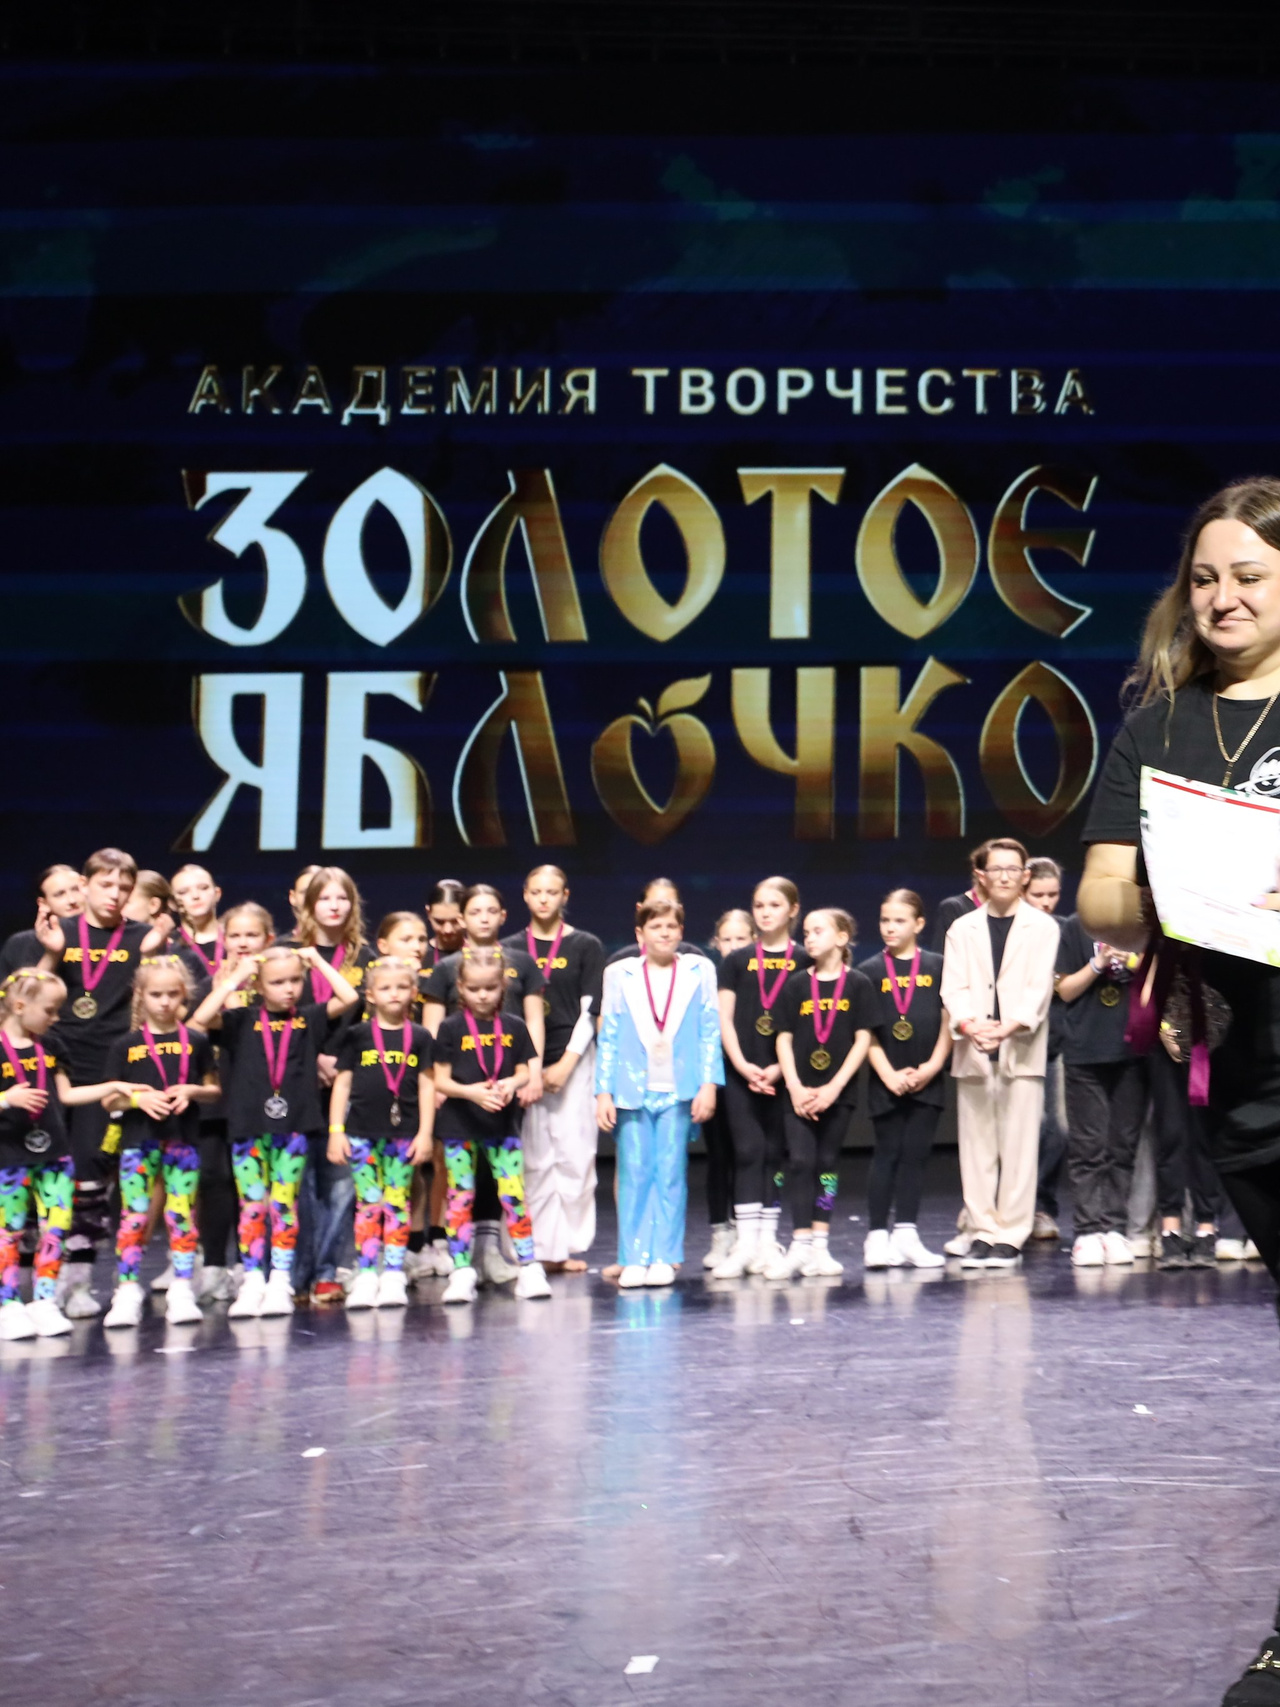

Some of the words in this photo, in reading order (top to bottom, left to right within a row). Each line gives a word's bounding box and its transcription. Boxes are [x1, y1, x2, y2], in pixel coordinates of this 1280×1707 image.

[188, 365, 597, 427] АКАДЕМИЯ
[632, 366, 1096, 416] ТВОРЧЕСТВА
[177, 463, 1100, 647] ЗОЛОТОЕ
[171, 655, 1100, 851] ЯБЛОЧКО
[62, 947, 130, 963] ДЕСТВО
[746, 957, 797, 972] ДТСТВО
[880, 974, 934, 994] ДТСВО
[799, 997, 850, 1017] ДЕСТВО
[127, 1041, 194, 1064] ДЕСТВО
[360, 1048, 419, 1068] ДЕСТО
